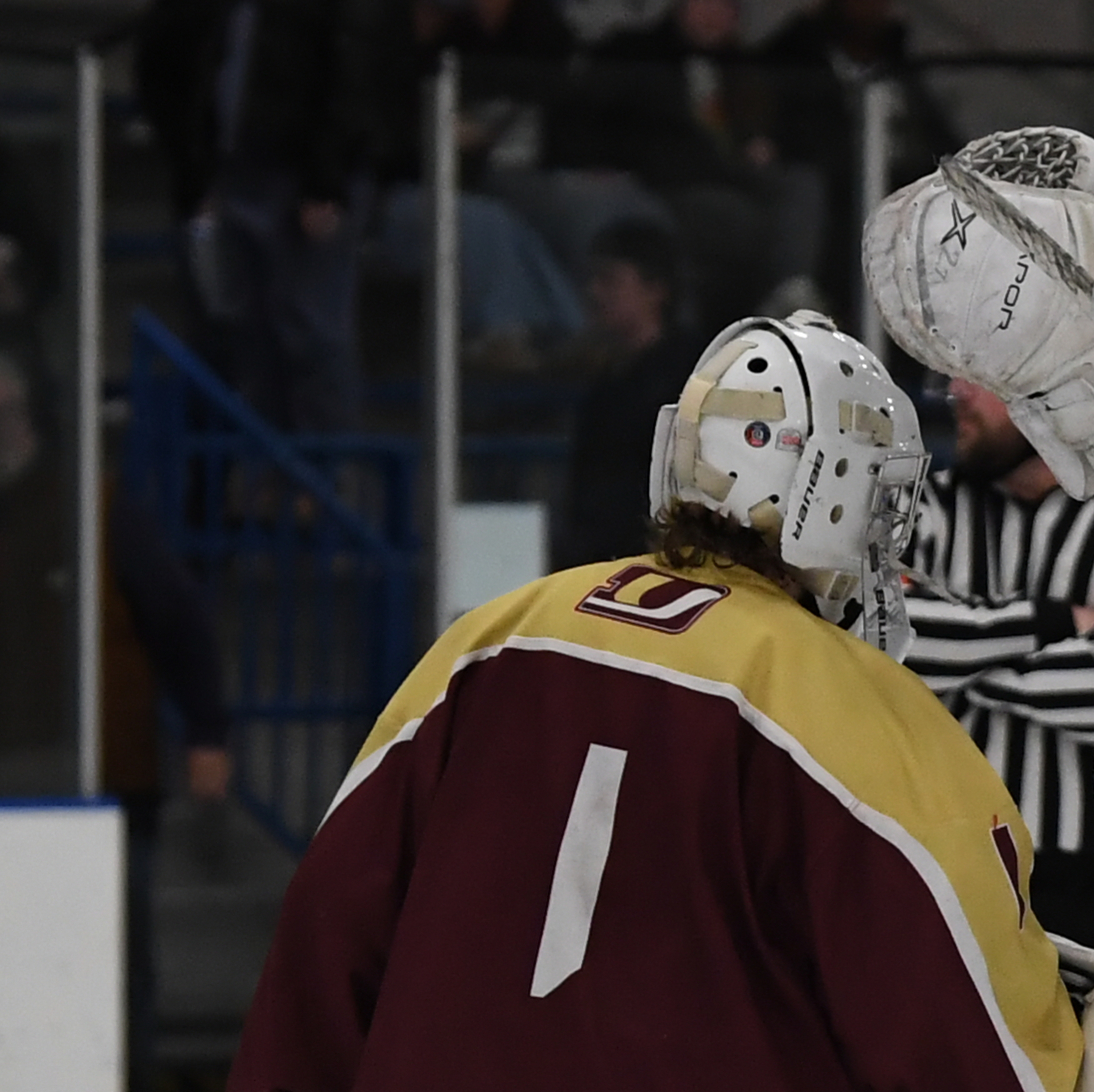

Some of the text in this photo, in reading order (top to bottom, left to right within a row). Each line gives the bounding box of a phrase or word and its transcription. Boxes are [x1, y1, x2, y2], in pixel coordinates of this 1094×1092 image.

[792, 449, 825, 540] BAUER
[873, 589, 887, 651] BAUE
[529, 743, 628, 998] 1
